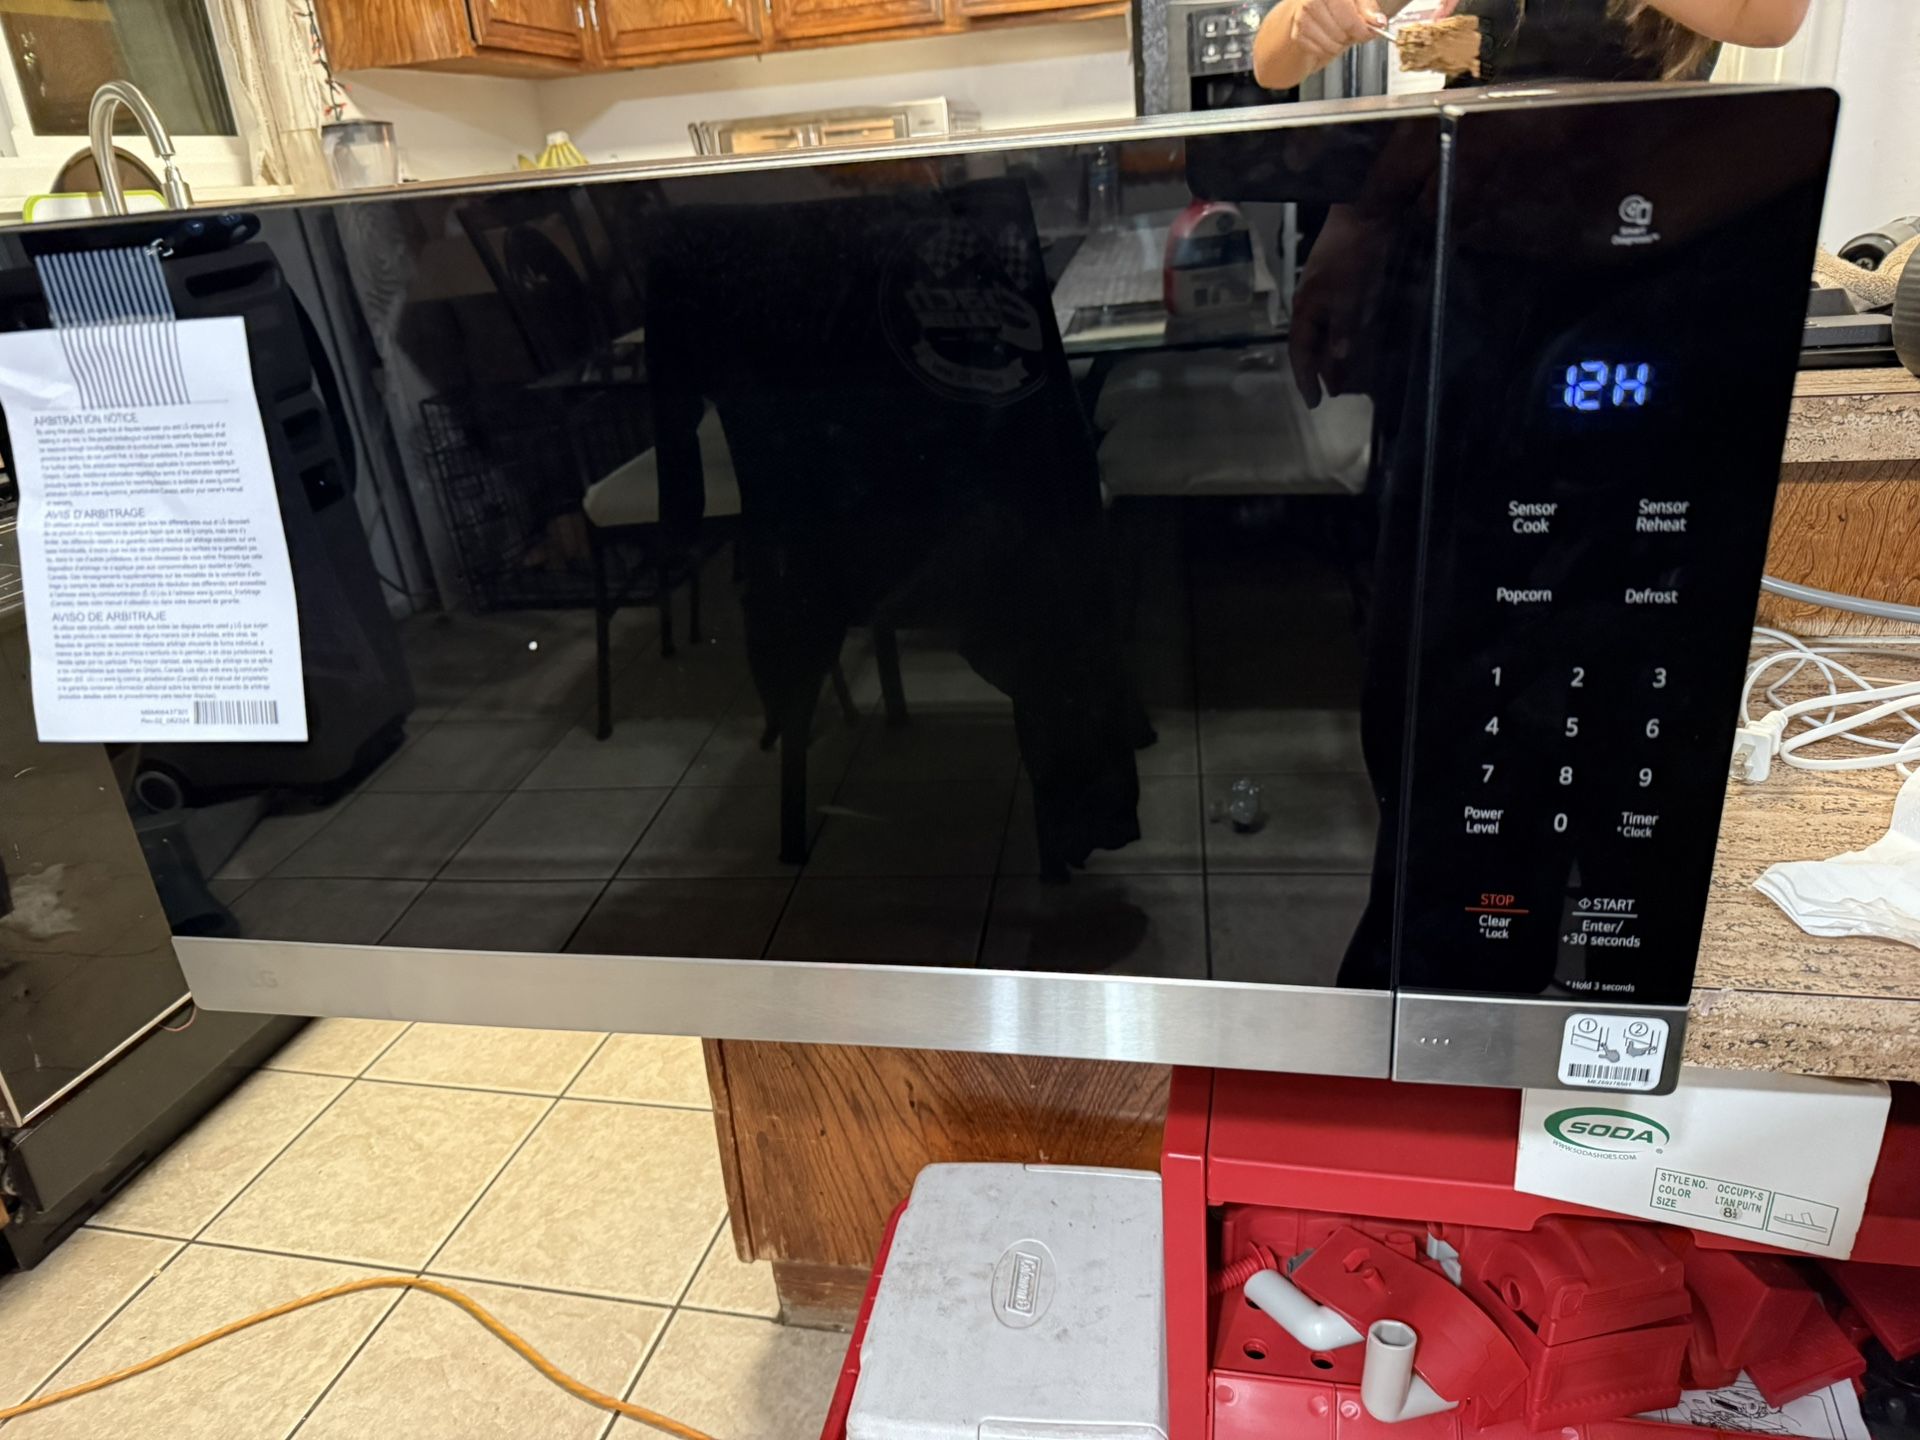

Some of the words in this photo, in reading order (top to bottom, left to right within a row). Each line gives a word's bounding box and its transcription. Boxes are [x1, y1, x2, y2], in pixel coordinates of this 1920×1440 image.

[34, 415, 102, 426] ARBITRATION
[103, 412, 139, 424] NOTICE
[45, 511, 71, 520] AVIS
[73, 508, 145, 519] D'ARBITRAGE
[1509, 501, 1557, 516] Sensor
[1639, 499, 1688, 514] Sensor
[1512, 518, 1549, 533] Cook
[1636, 516, 1686, 532] Reheat
[1496, 587, 1552, 604] Popcorn
[1625, 588, 1677, 603] Defrost
[52, 613, 85, 622] AVISO
[87, 613, 103, 622] DE
[106, 611, 166, 622] ARBITRAJE
[1492, 667, 1501, 686] 1
[1571, 667, 1585, 687] 2
[1652, 667, 1667, 688] 3
[1485, 716, 1499, 735] 4
[1565, 717, 1578, 737] 5
[1646, 718, 1659, 738] 6
[1482, 764, 1494, 783] 7
[1559, 766, 1573, 785] 8
[1639, 768, 1652, 787] 9
[1464, 806, 1504, 819] Power
[1622, 811, 1658, 825] Timer
[1466, 822, 1499, 834] Level
[1553, 813, 1568, 832] 0
[1480, 893, 1514, 906] STOP
[1593, 898, 1634, 911] START
[1478, 914, 1511, 927] Clear
[1581, 919, 1624, 934] Enter/
[1562, 932, 1587, 945] +30
[1591, 935, 1641, 947] seconds
[1594, 981, 1600, 991] 3
[1602, 983, 1635, 992] seconds
[1568, 1122, 1654, 1144] SODA
[1552, 1139, 1637, 1160] WWW.SODASHOES.COM
[1660, 1172, 1690, 1186] STYLE
[1691, 1178, 1708, 1190] NO.
[1717, 1184, 1764, 1201] OCCUPY-S
[1656, 1196, 1677, 1208] SIZE
[1658, 1184, 1692, 1199] COLOR
[1714, 1196, 1736, 1208] LTAN
[1736, 1200, 1762, 1213] PU/TN
